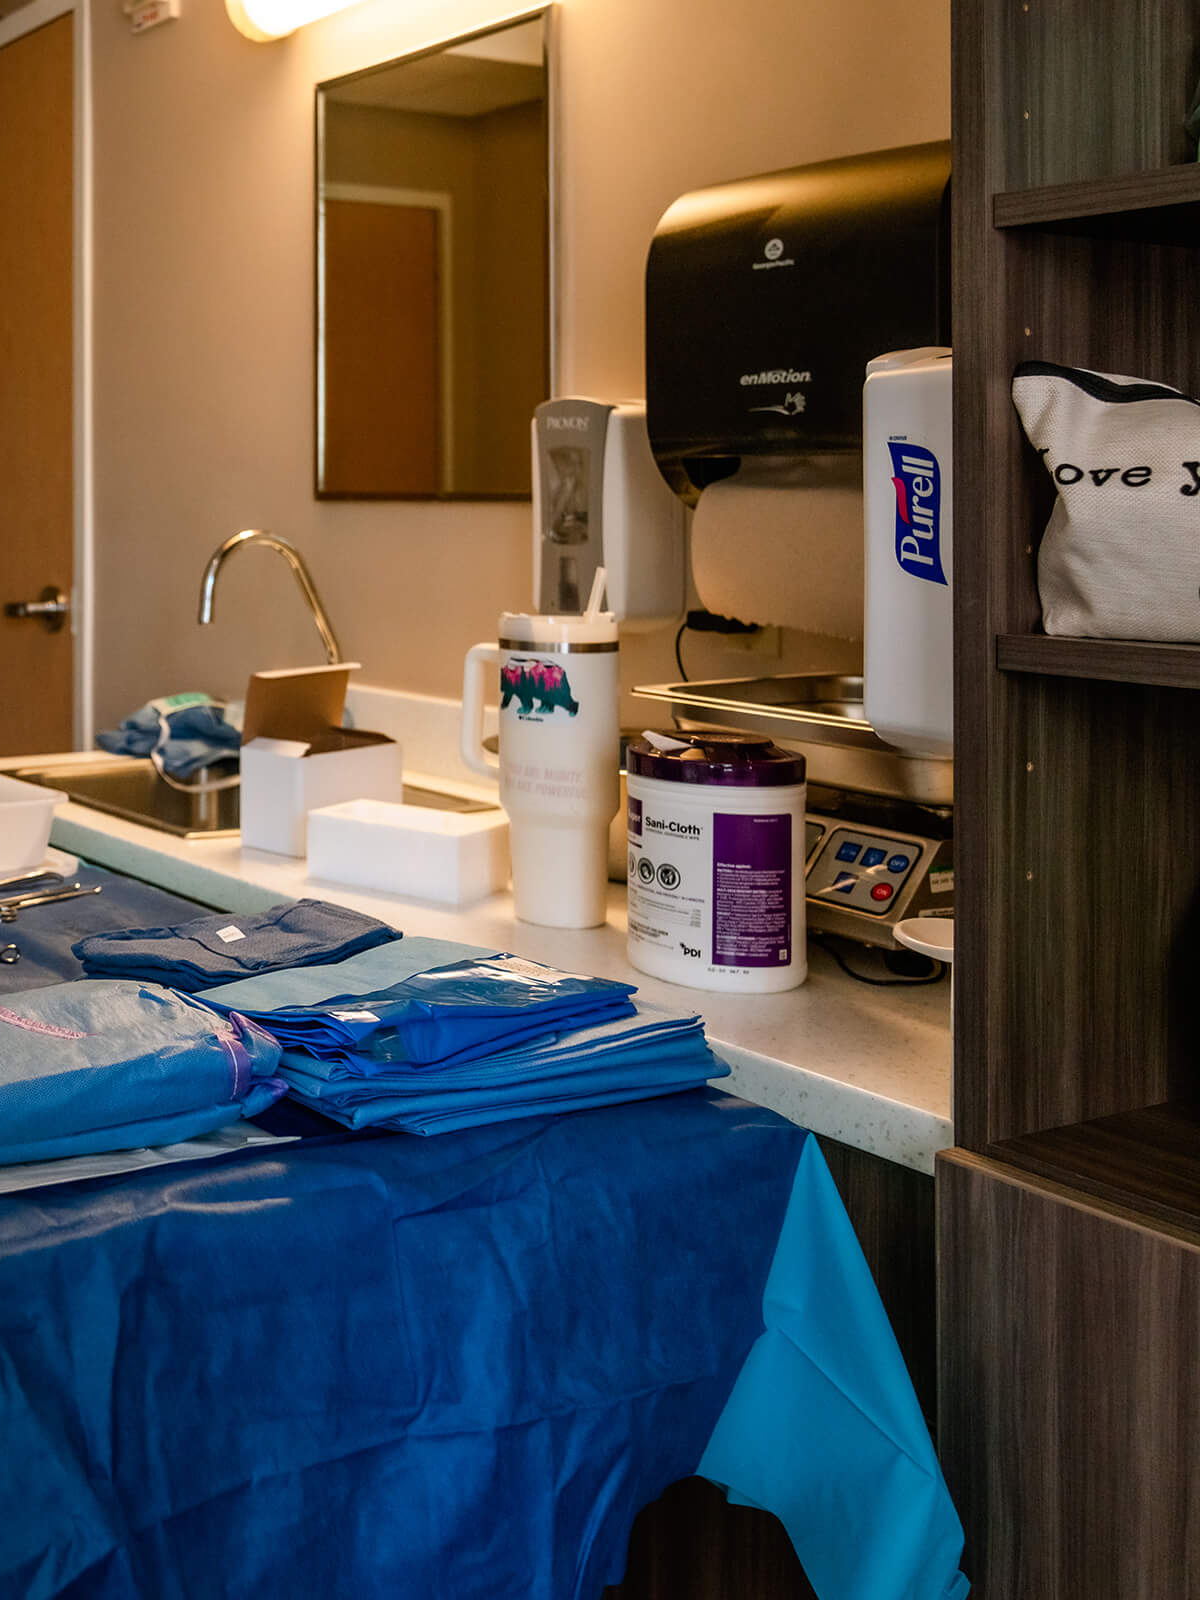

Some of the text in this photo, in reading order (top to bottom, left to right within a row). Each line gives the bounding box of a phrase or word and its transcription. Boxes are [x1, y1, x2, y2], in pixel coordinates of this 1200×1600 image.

[740, 369, 811, 386] enMotion
[1049, 461, 1152, 487] ove
[900, 455, 935, 566] Purell
[645, 816, 701, 836] Sani-Cloth
[876, 887, 888, 896] ON
[683, 947, 701, 959] PDI
